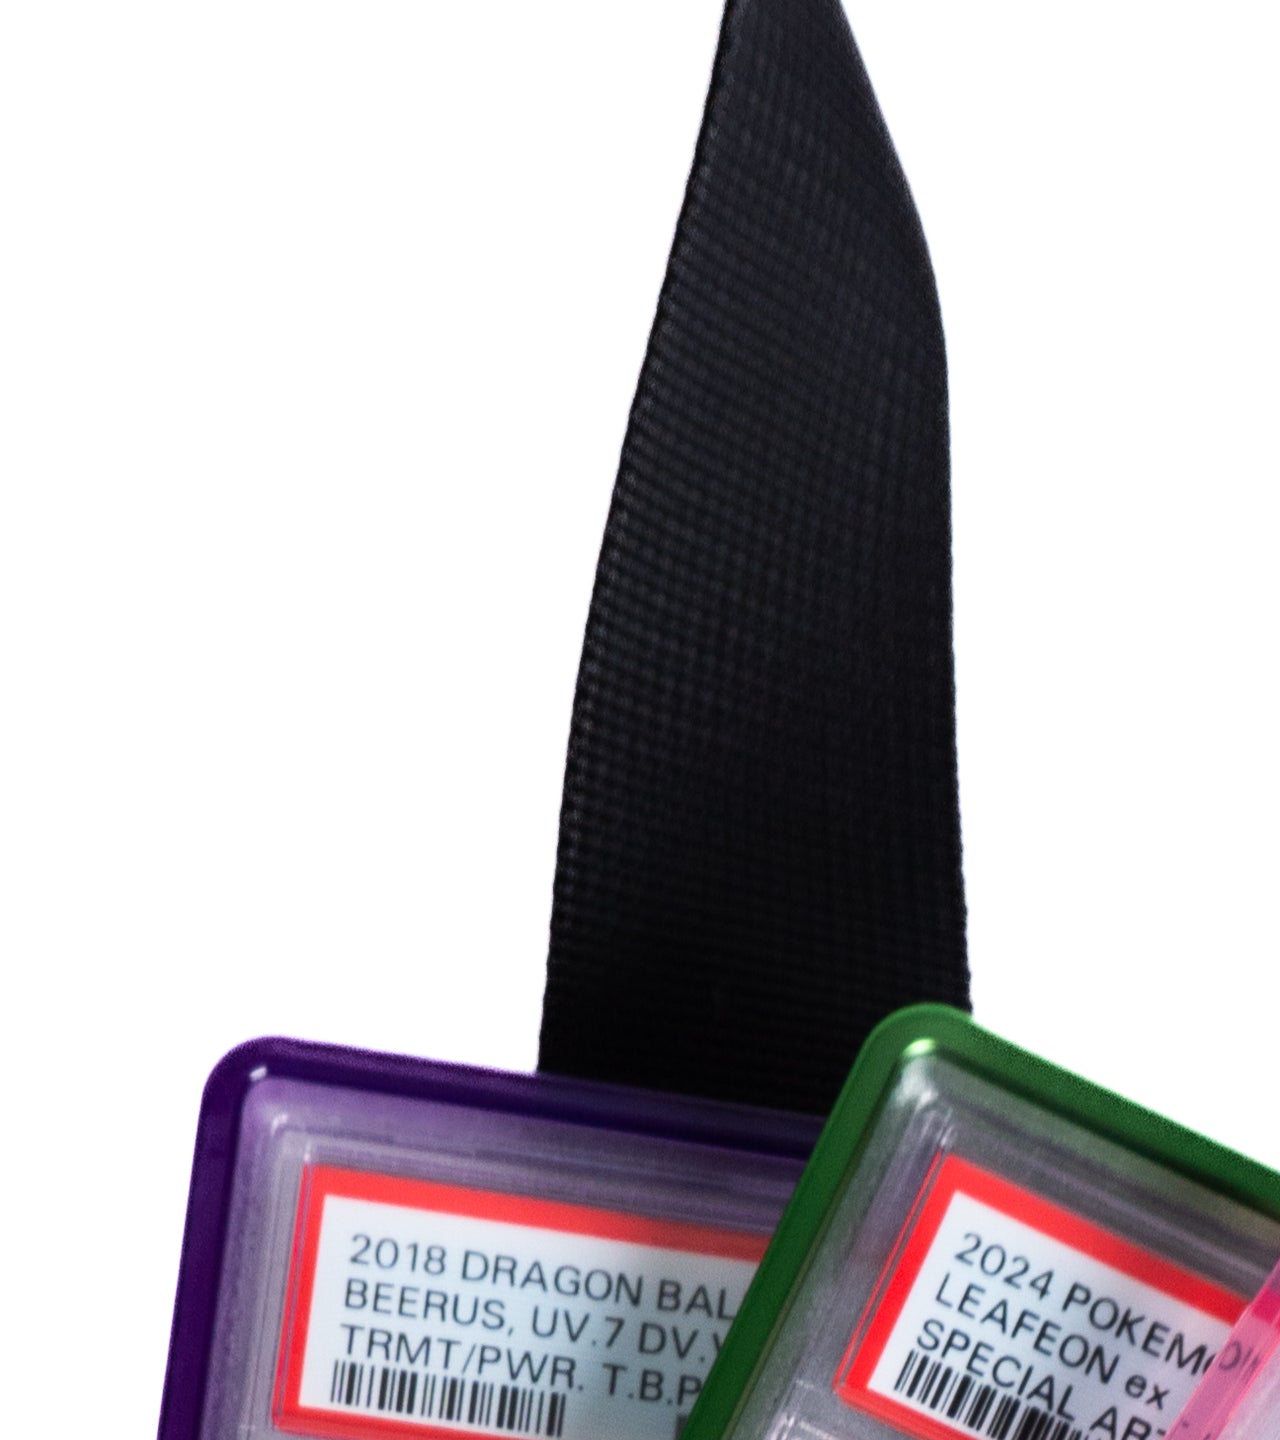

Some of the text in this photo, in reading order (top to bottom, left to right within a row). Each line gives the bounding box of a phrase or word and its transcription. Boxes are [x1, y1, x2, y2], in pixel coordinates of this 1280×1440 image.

[349, 1233, 447, 1276] 2018
[460, 1248, 644, 1307] DRAGON
[954, 1232, 1056, 1301] 2024
[343, 1278, 515, 1337] BEERUS,
[934, 1271, 1171, 1411] LEAFEON ex
[338, 1322, 585, 1391] TRMT/PWR.
[916, 1318, 1077, 1423] SPECIAL
